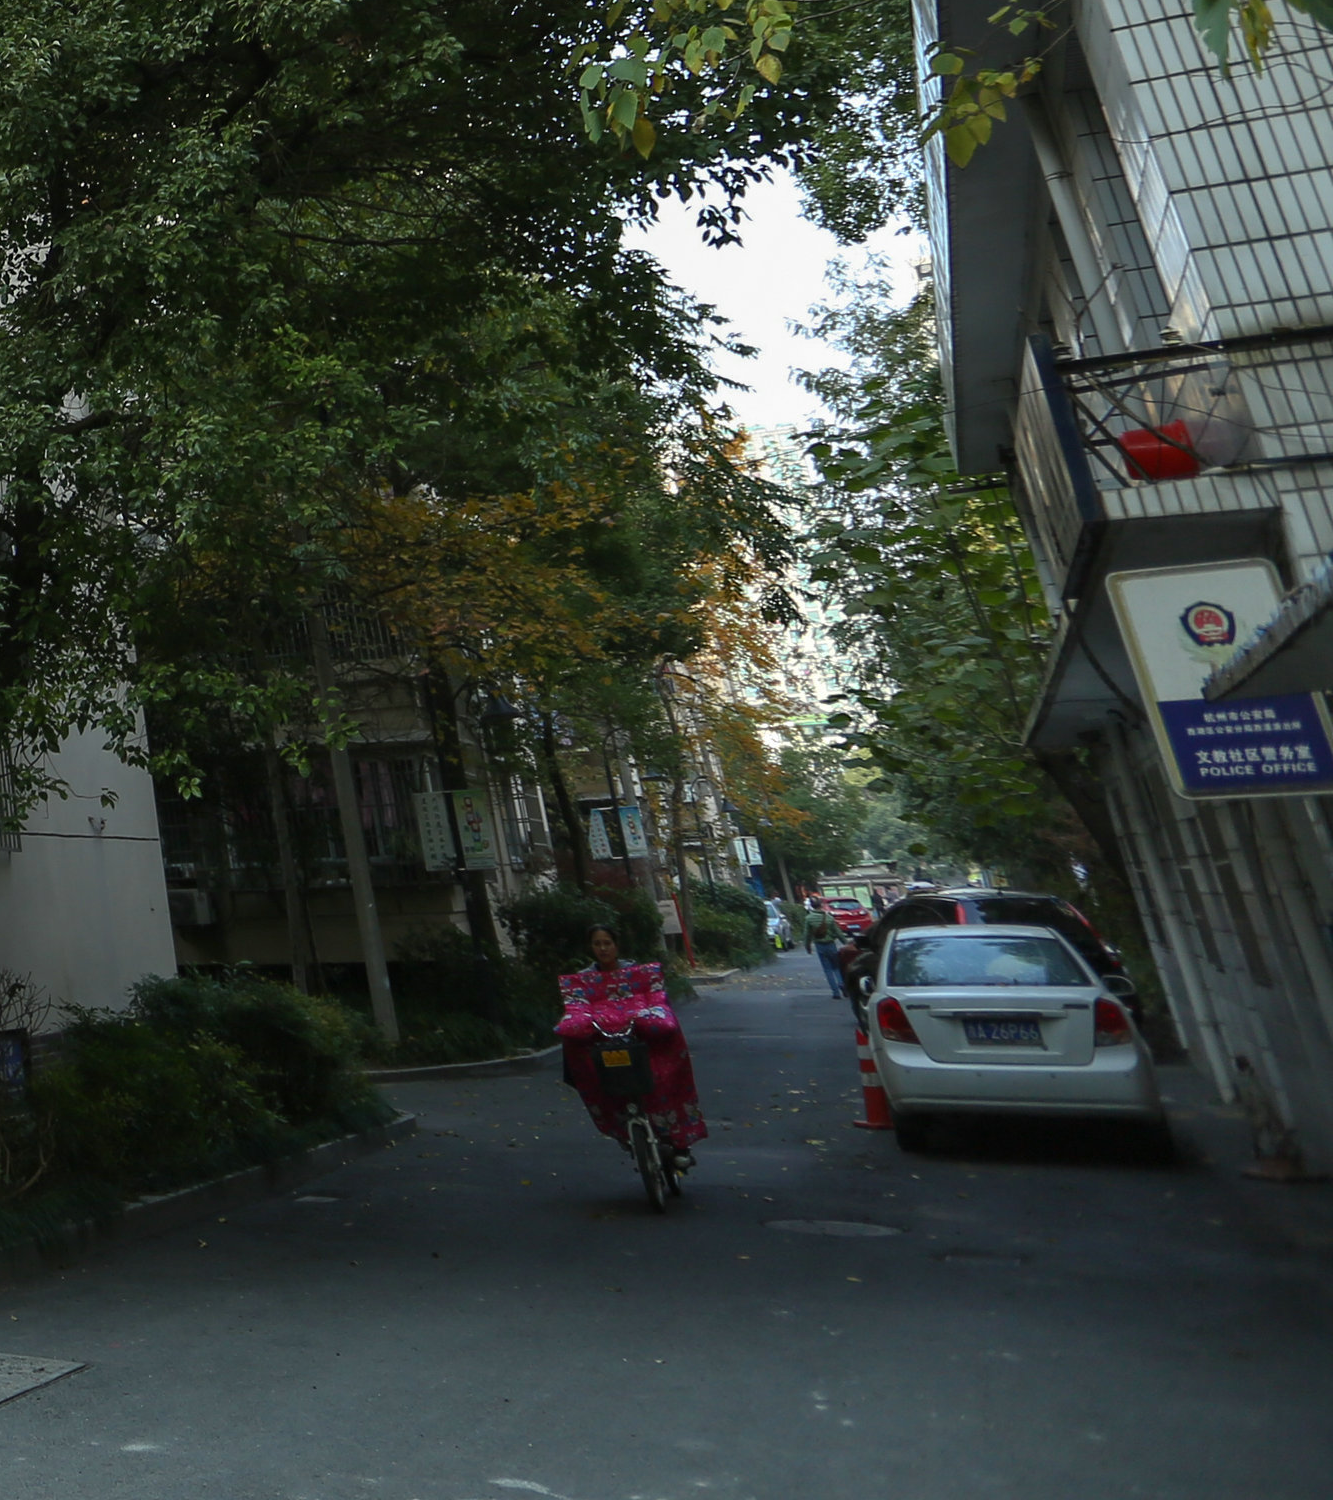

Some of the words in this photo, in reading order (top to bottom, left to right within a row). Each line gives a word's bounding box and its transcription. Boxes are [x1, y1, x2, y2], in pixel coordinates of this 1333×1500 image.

[1203, 709, 1276, 722] 杭州市公安局
[1196, 745, 1312, 764] 文教社区警务室
[1199, 764, 1255, 777] POLICE
[1261, 761, 1317, 774] OFFICE
